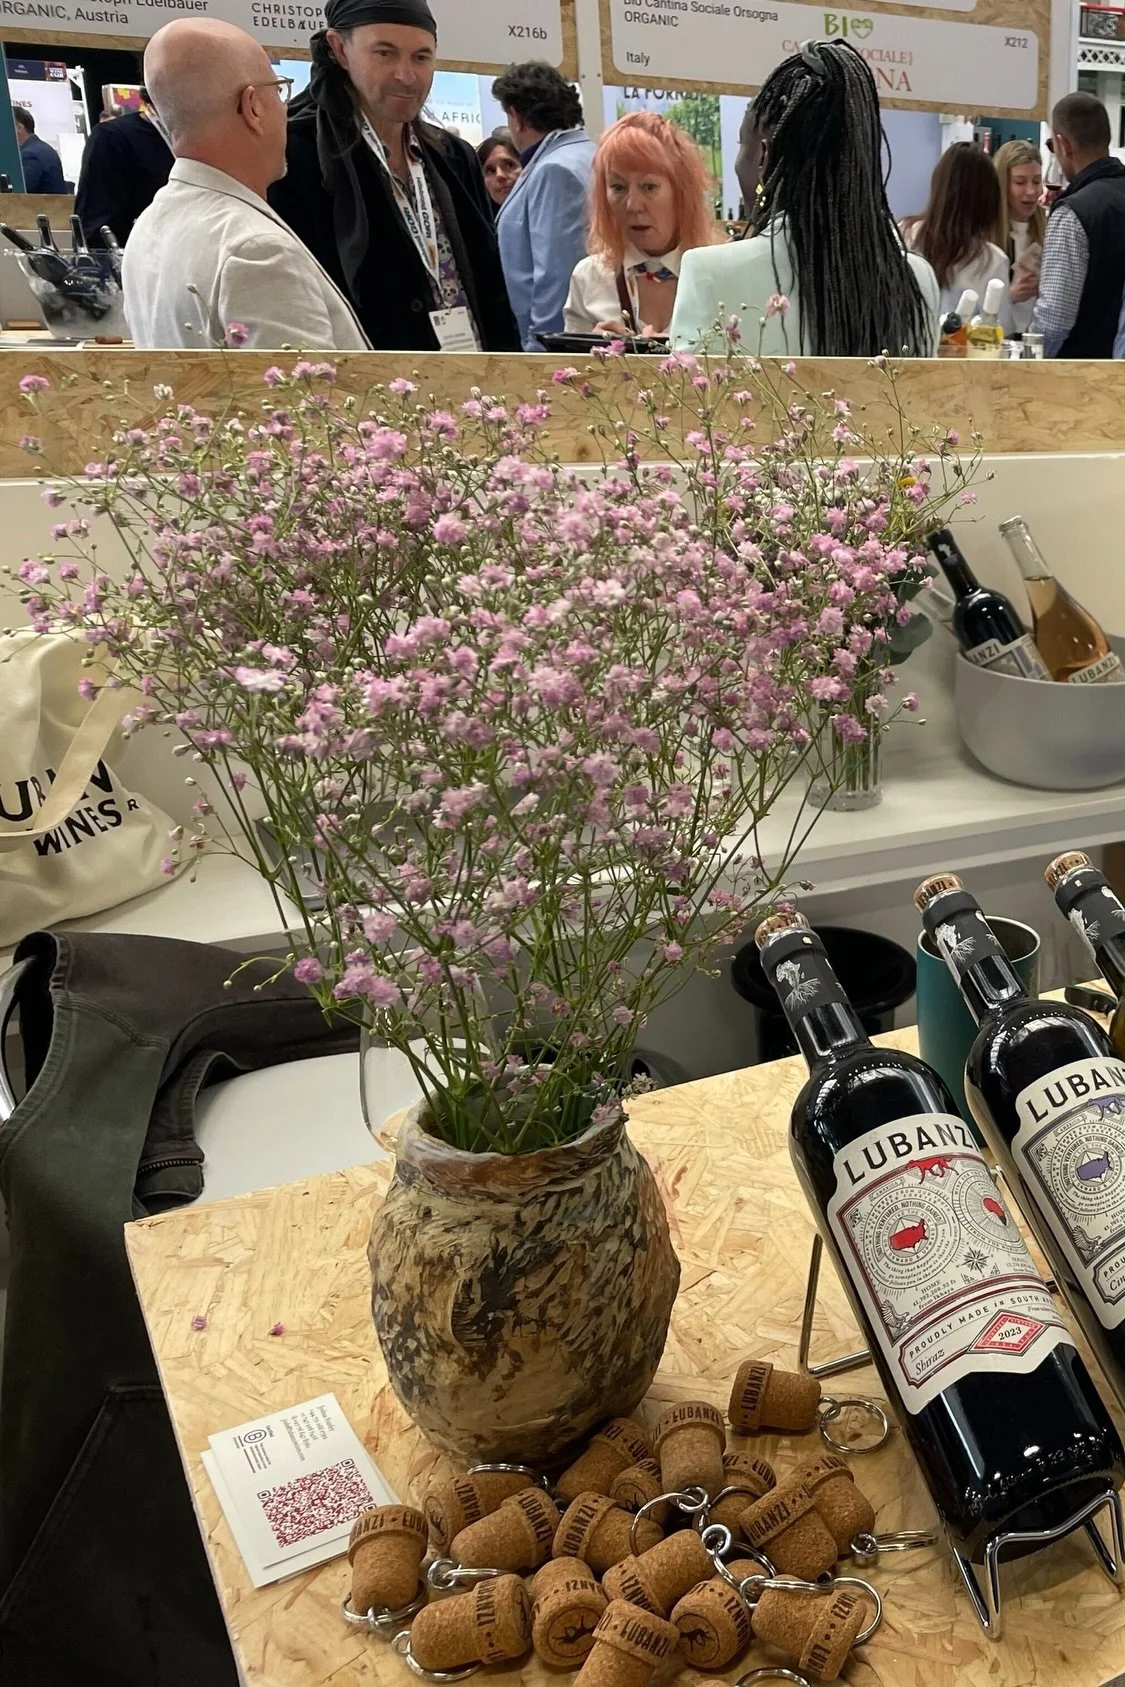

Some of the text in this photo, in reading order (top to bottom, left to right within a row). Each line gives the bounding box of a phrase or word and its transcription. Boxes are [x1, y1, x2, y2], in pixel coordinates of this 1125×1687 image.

[75, 8, 129, 24] Austria
[251, 2, 323, 17] CHRISTOP
[690, 1, 731, 16] Sociale
[733, 6, 779, 22] Orsogna
[253, 16, 325, 31] EDELBAUE
[624, 11, 679, 27] ORGANIC
[507, 24, 548, 40] X216b
[1004, 36, 1028, 49] X212
[626, 51, 650, 66] Italy
[12, 100, 33, 108] INES
[442, 111, 481, 124] AFRIC
[33, 798, 122, 857] WINES
[842, 1121, 976, 1187] LUBANZ
[921, 1279, 941, 1294] HOME
[908, 1321, 955, 1360] PROUDLY
[958, 1305, 991, 1325] MADE
[1010, 1295, 1040, 1306] SOUTH
[998, 1326, 1023, 1342] 2023
[914, 1347, 946, 1377] Shiraz
